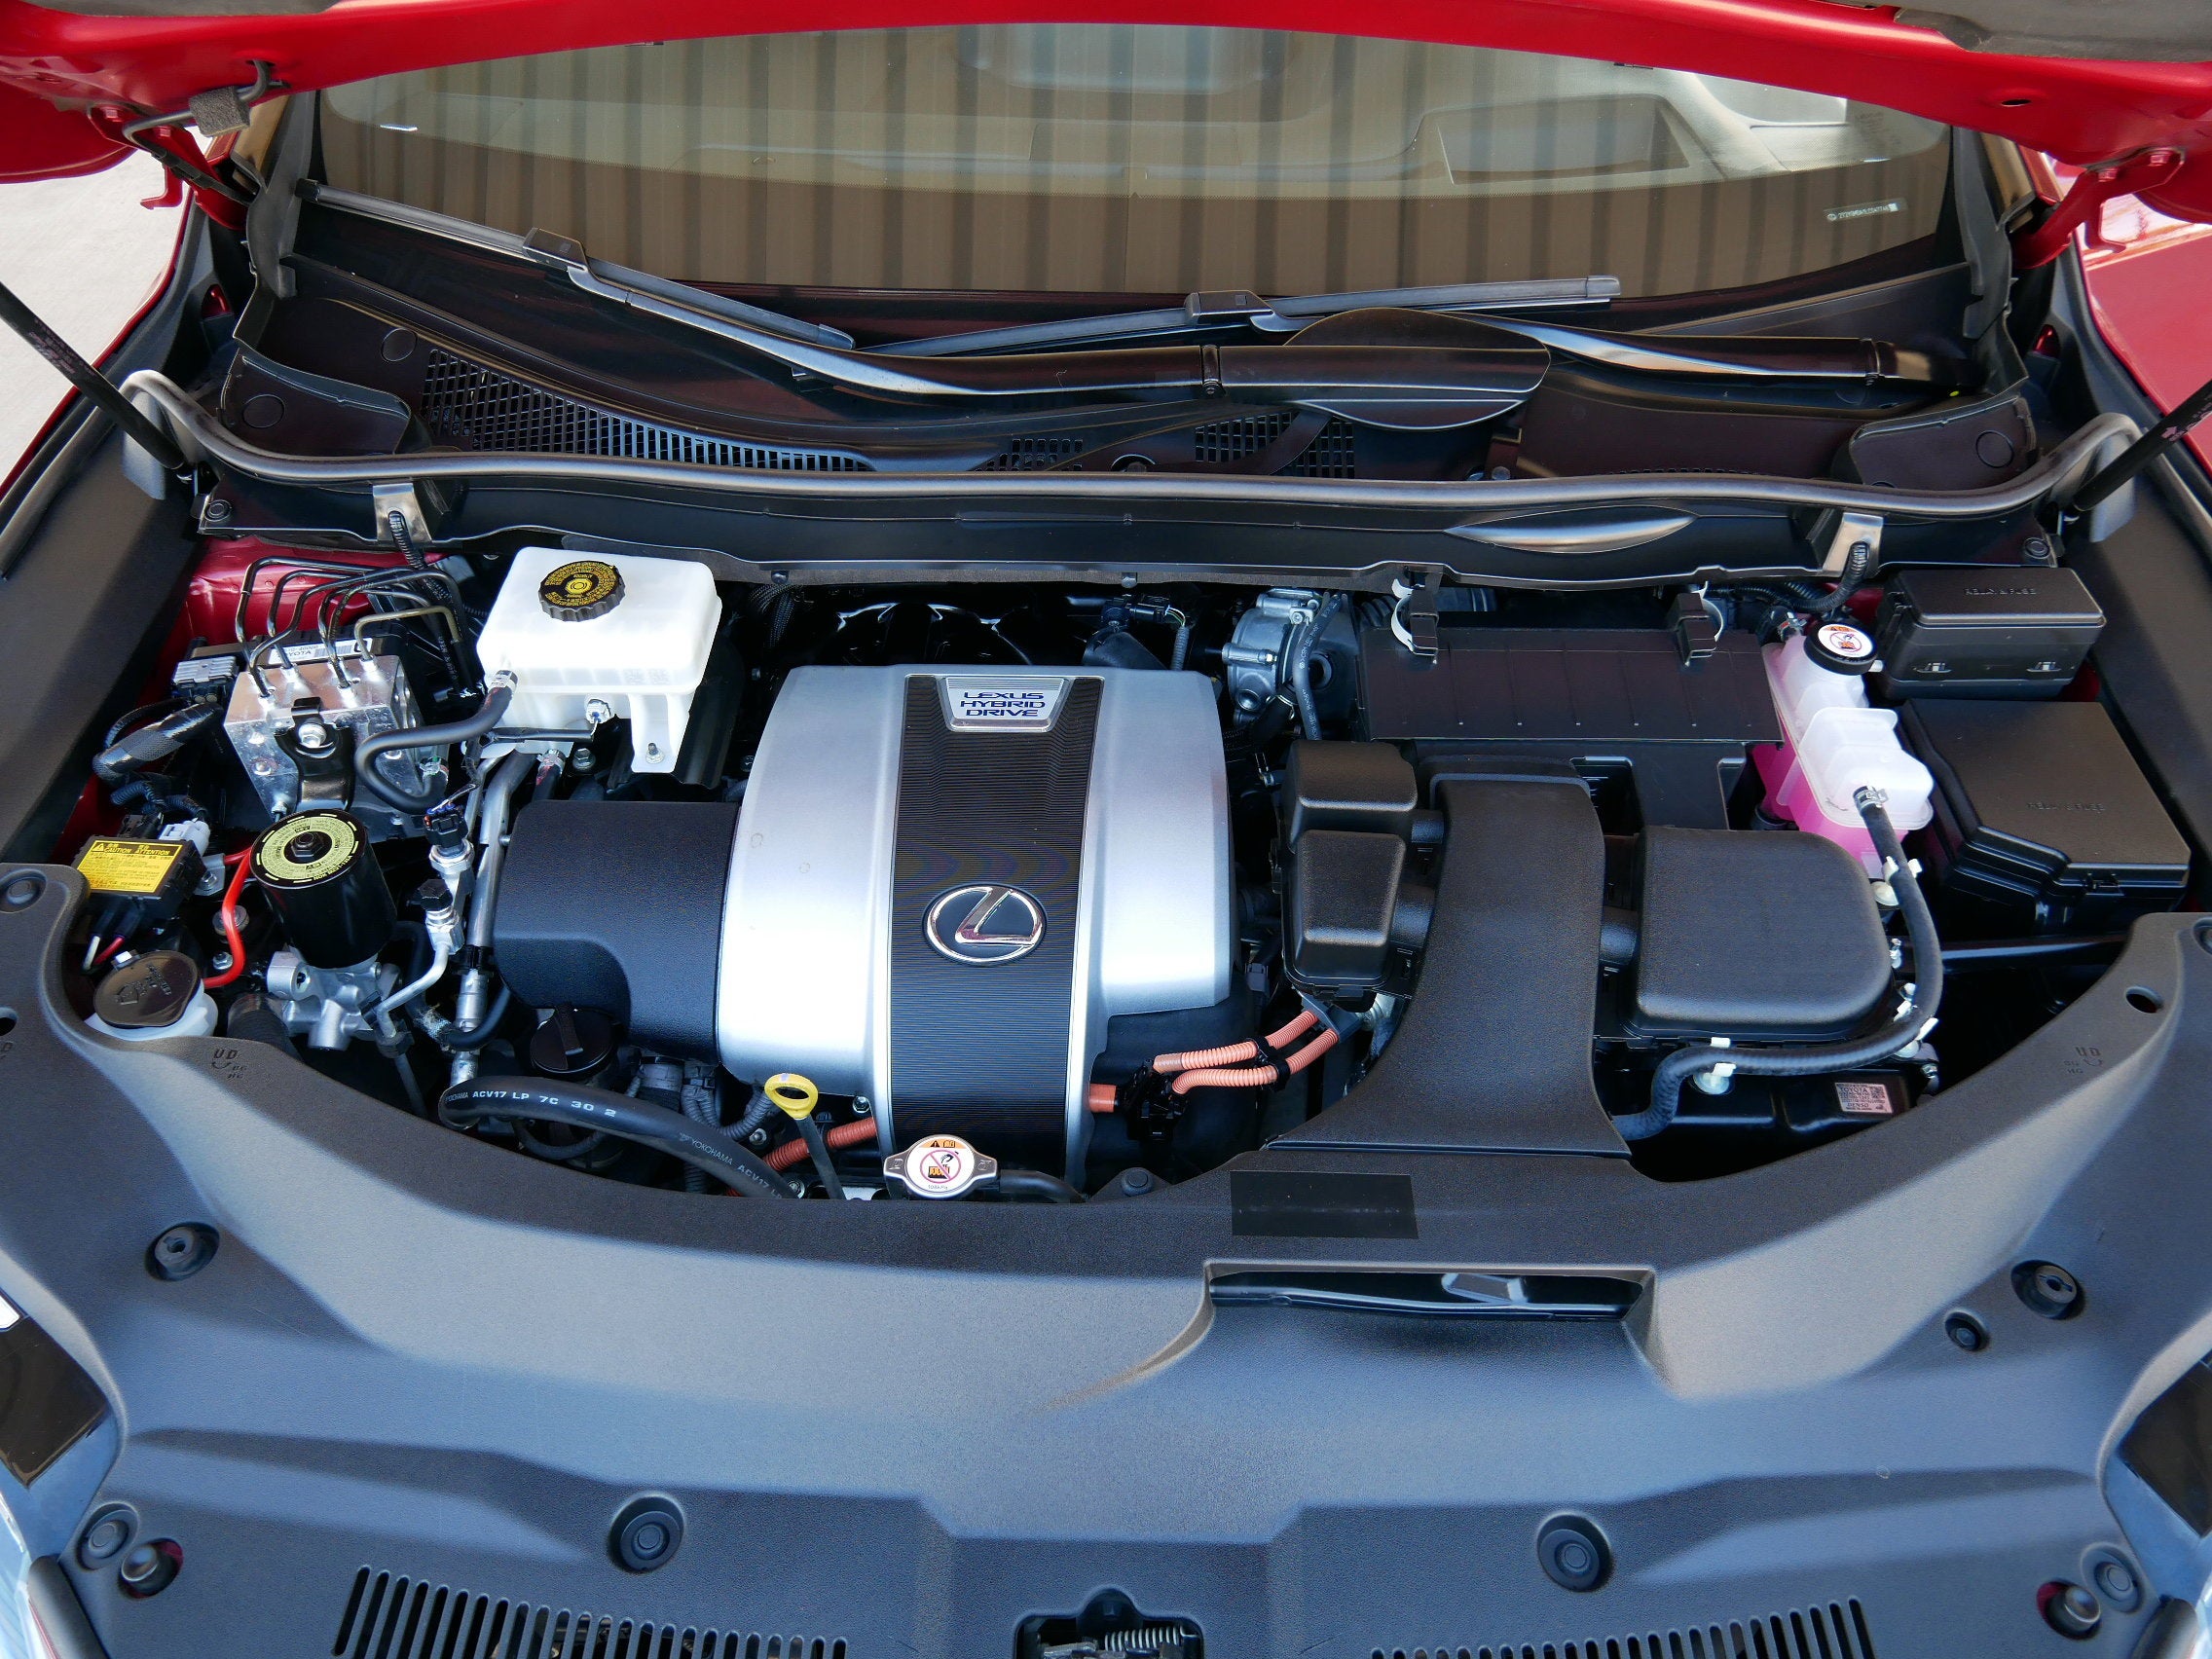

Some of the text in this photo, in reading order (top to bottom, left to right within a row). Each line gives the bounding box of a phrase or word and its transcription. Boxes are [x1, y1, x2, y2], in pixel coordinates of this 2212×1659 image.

[539, 1095, 559, 1105] 7C
[604, 1108, 616, 1118] 2
[691, 1138, 733, 1165] YOKOHAMA
[737, 1163, 769, 1189] ACV17
